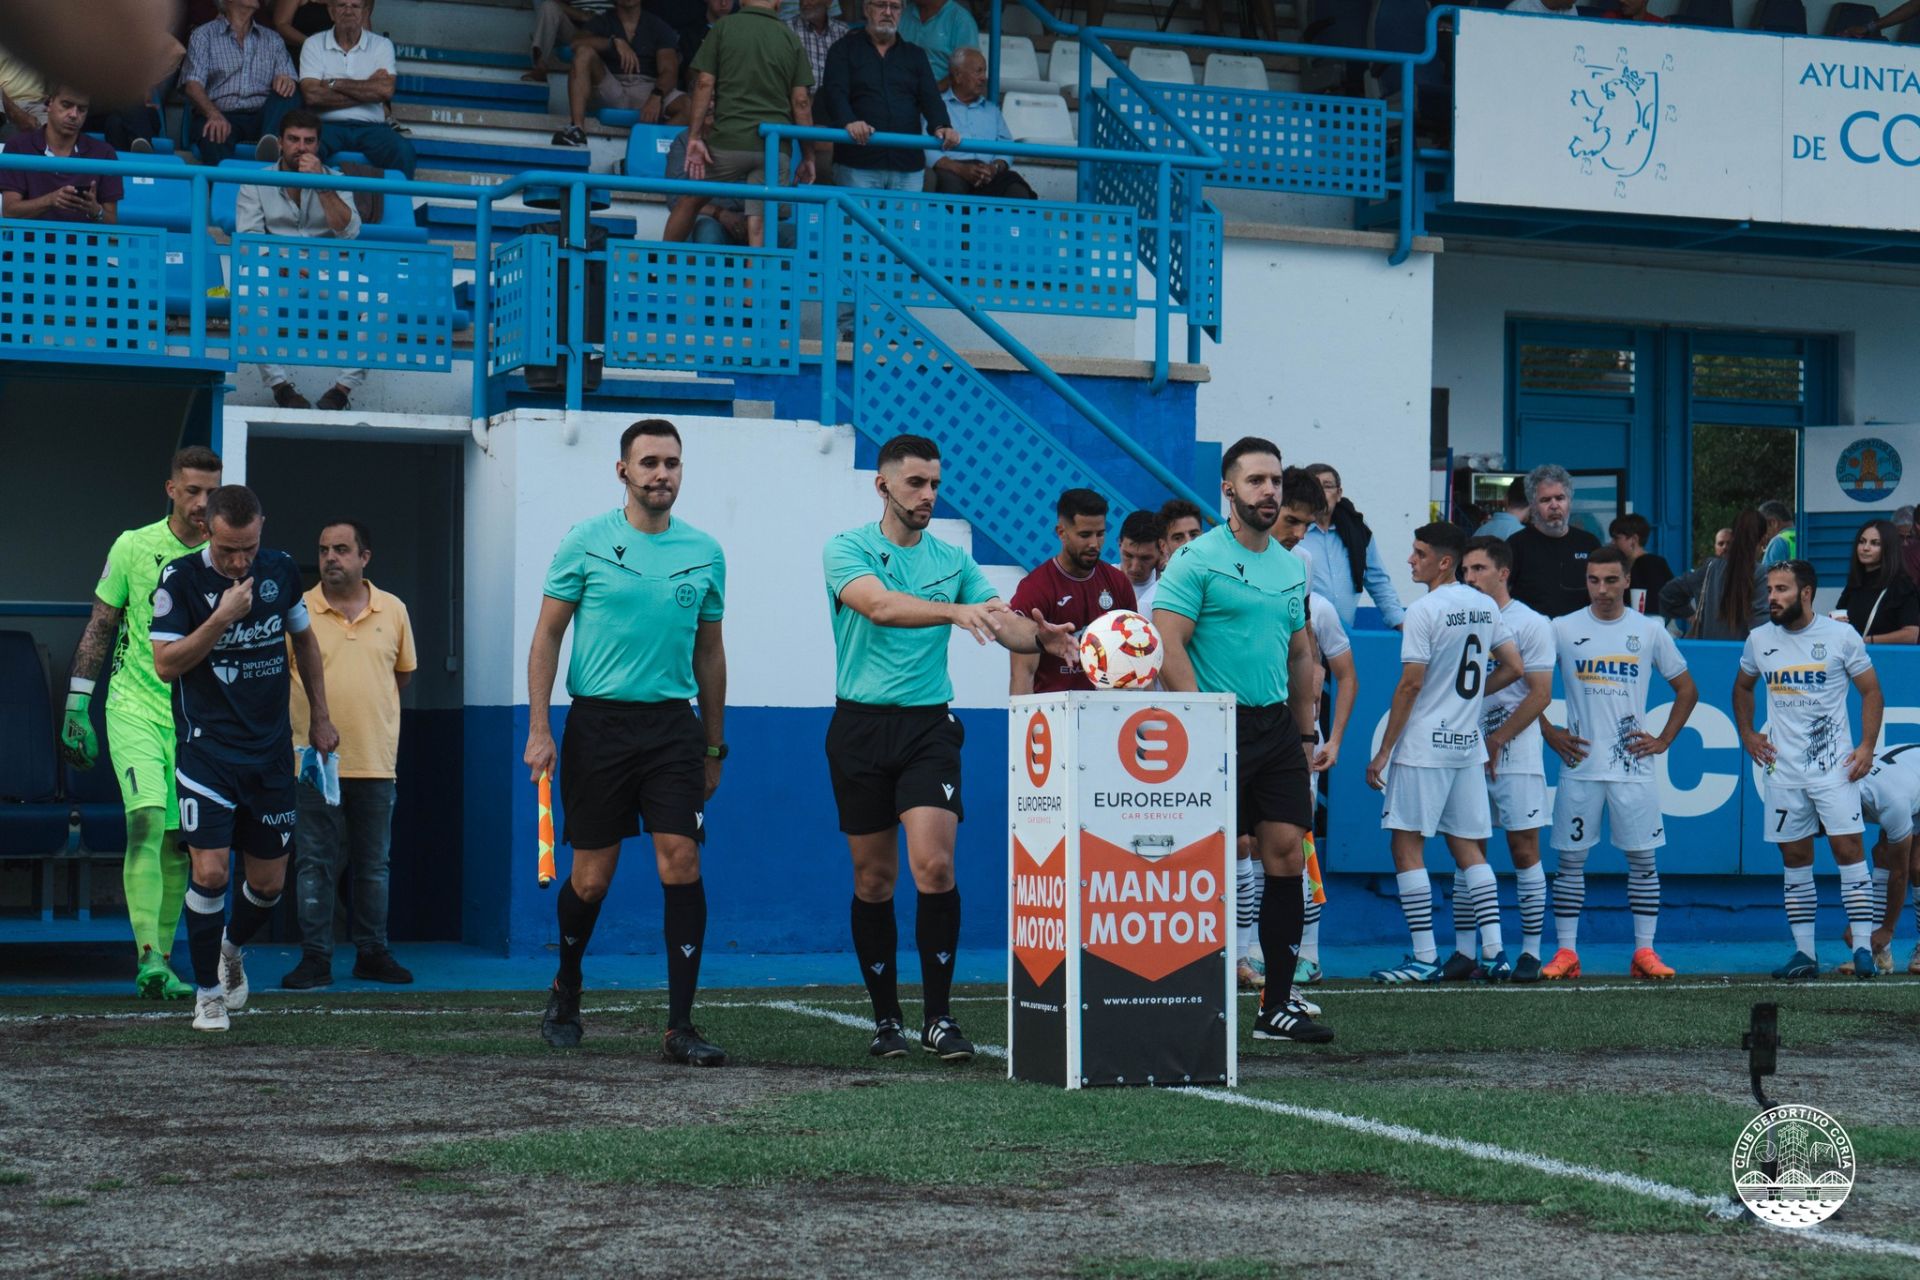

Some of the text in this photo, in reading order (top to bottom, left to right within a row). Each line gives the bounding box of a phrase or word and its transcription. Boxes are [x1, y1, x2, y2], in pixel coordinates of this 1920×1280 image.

[1799, 62, 1920, 94] AYUNTA
[1793, 110, 1920, 167] DE CO
[1455, 633, 1482, 700] 6
[1575, 659, 1639, 677] VIALES
[1764, 670, 1827, 685] VIALES
[125, 766, 139, 796] 1
[178, 797, 199, 832] 10
[1018, 796, 1062, 812] EUROREPAR
[1094, 792, 1212, 808] EUROREPAR
[1121, 812, 1184, 820] CAR SERVICE
[1570, 816, 1584, 842] 3
[1775, 808, 1788, 832] 7
[1016, 874, 1063, 910] MANJO
[1089, 869, 1216, 903] MANJO
[1016, 915, 1064, 951] MOTOR
[1089, 911, 1217, 945] MOTOR
[1103, 995, 1203, 1006] www.eurorepar.es
